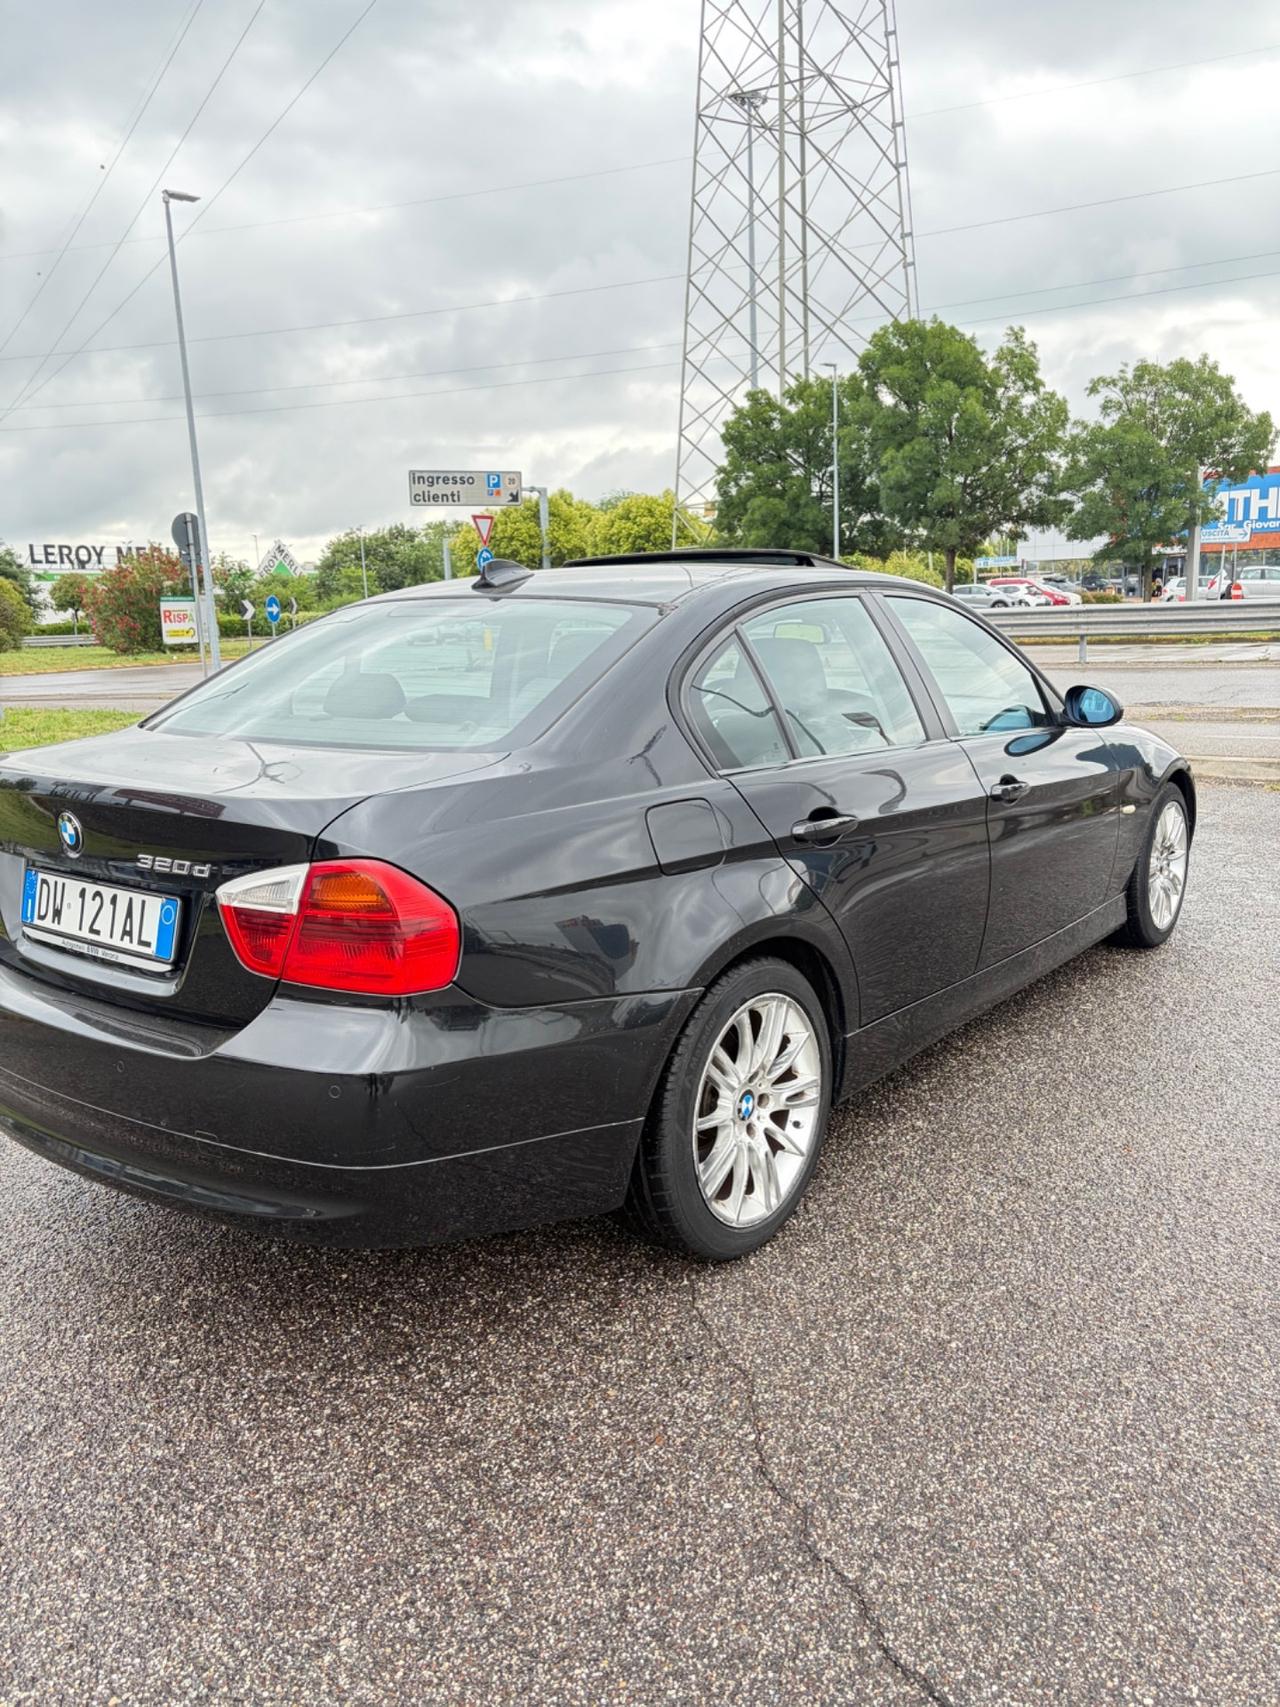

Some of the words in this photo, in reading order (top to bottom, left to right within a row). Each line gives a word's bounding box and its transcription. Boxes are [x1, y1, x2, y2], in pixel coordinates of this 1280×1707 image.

[412, 473, 475, 487] ingresso
[490, 475, 498, 487] P
[413, 490, 461, 503] clienti
[29, 544, 105, 565] LEROY
[136, 854, 211, 878] 320d
[78, 887, 152, 948] 121AL
